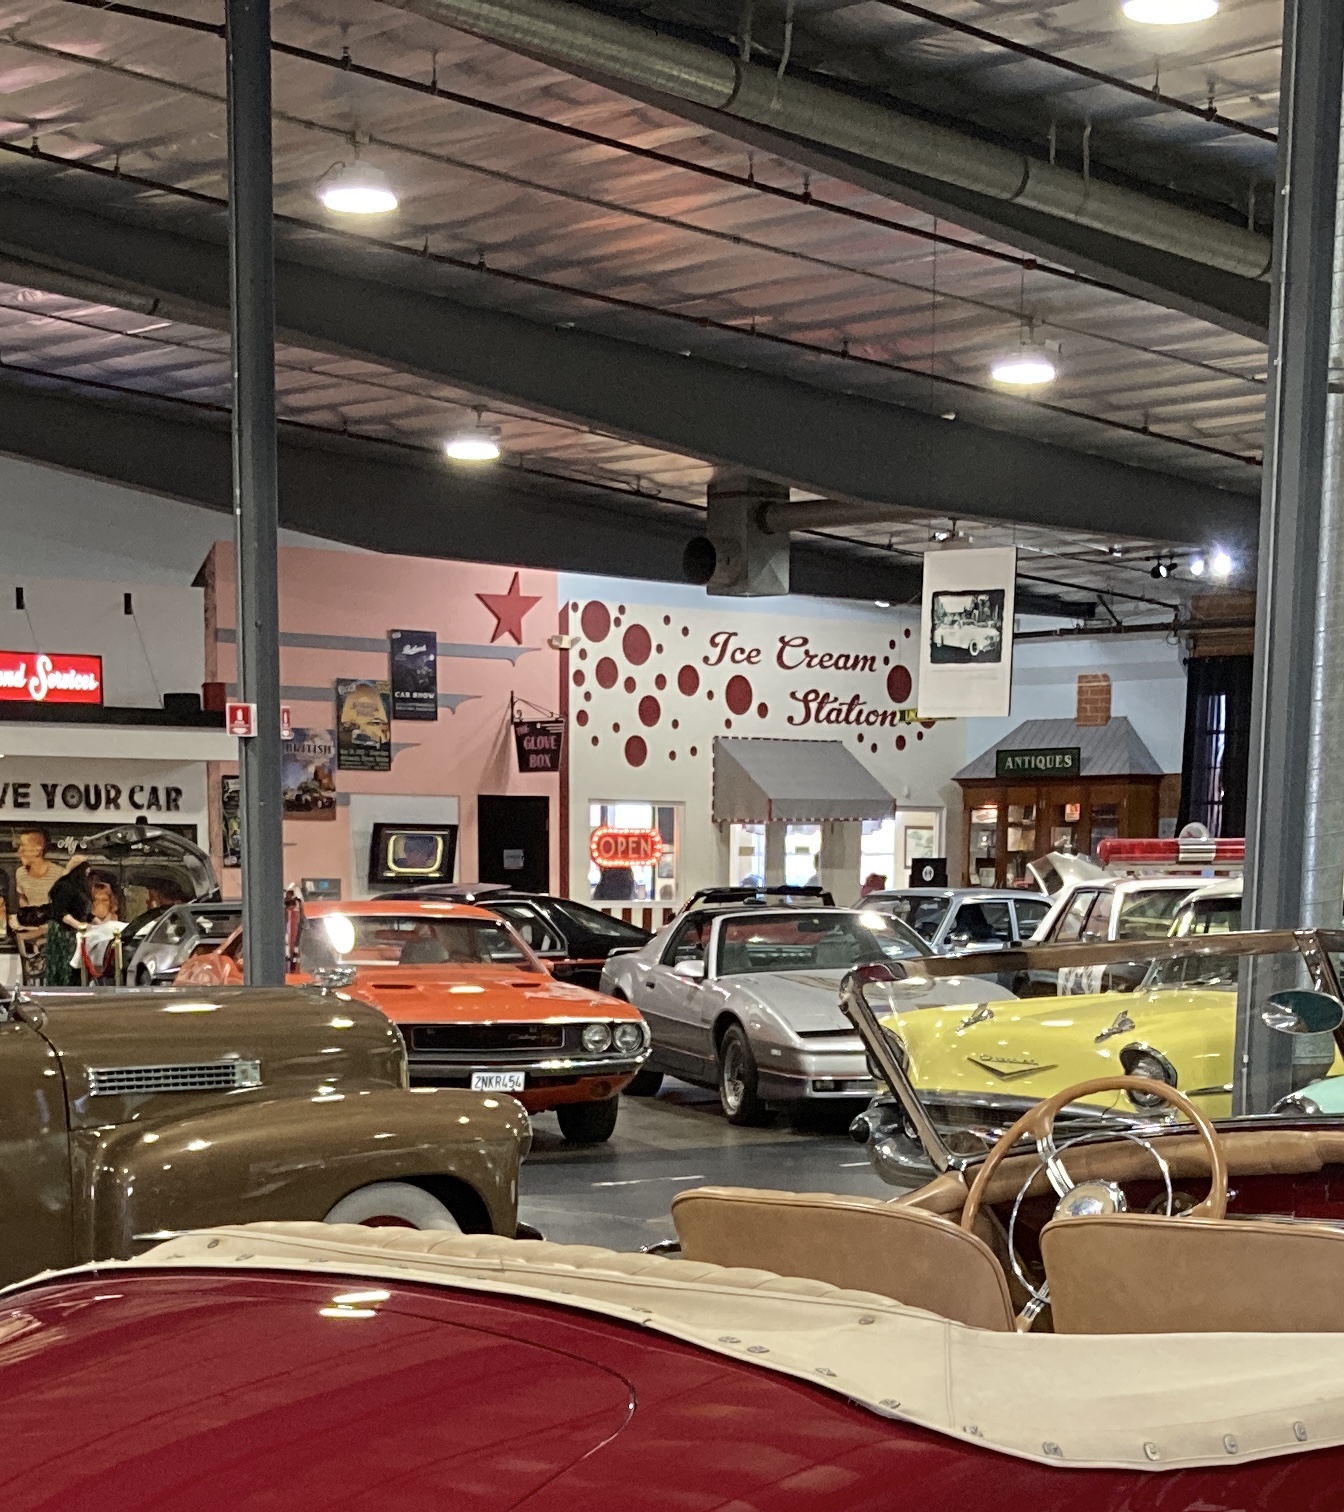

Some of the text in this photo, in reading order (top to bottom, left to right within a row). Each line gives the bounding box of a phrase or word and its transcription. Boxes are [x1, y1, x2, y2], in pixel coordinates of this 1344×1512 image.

[702, 631, 877, 672] Ice Cream
[787, 688, 899, 727] Station
[523, 735, 557, 751] GLOVE
[529, 753, 552, 769] BOX
[1004, 754, 1073, 770] ANTIQUES
[40, 782, 122, 811] YOUR
[128, 784, 183, 812] CAR
[599, 836, 652, 858] OPEN
[473, 1073, 522, 1090] 2NKR454
